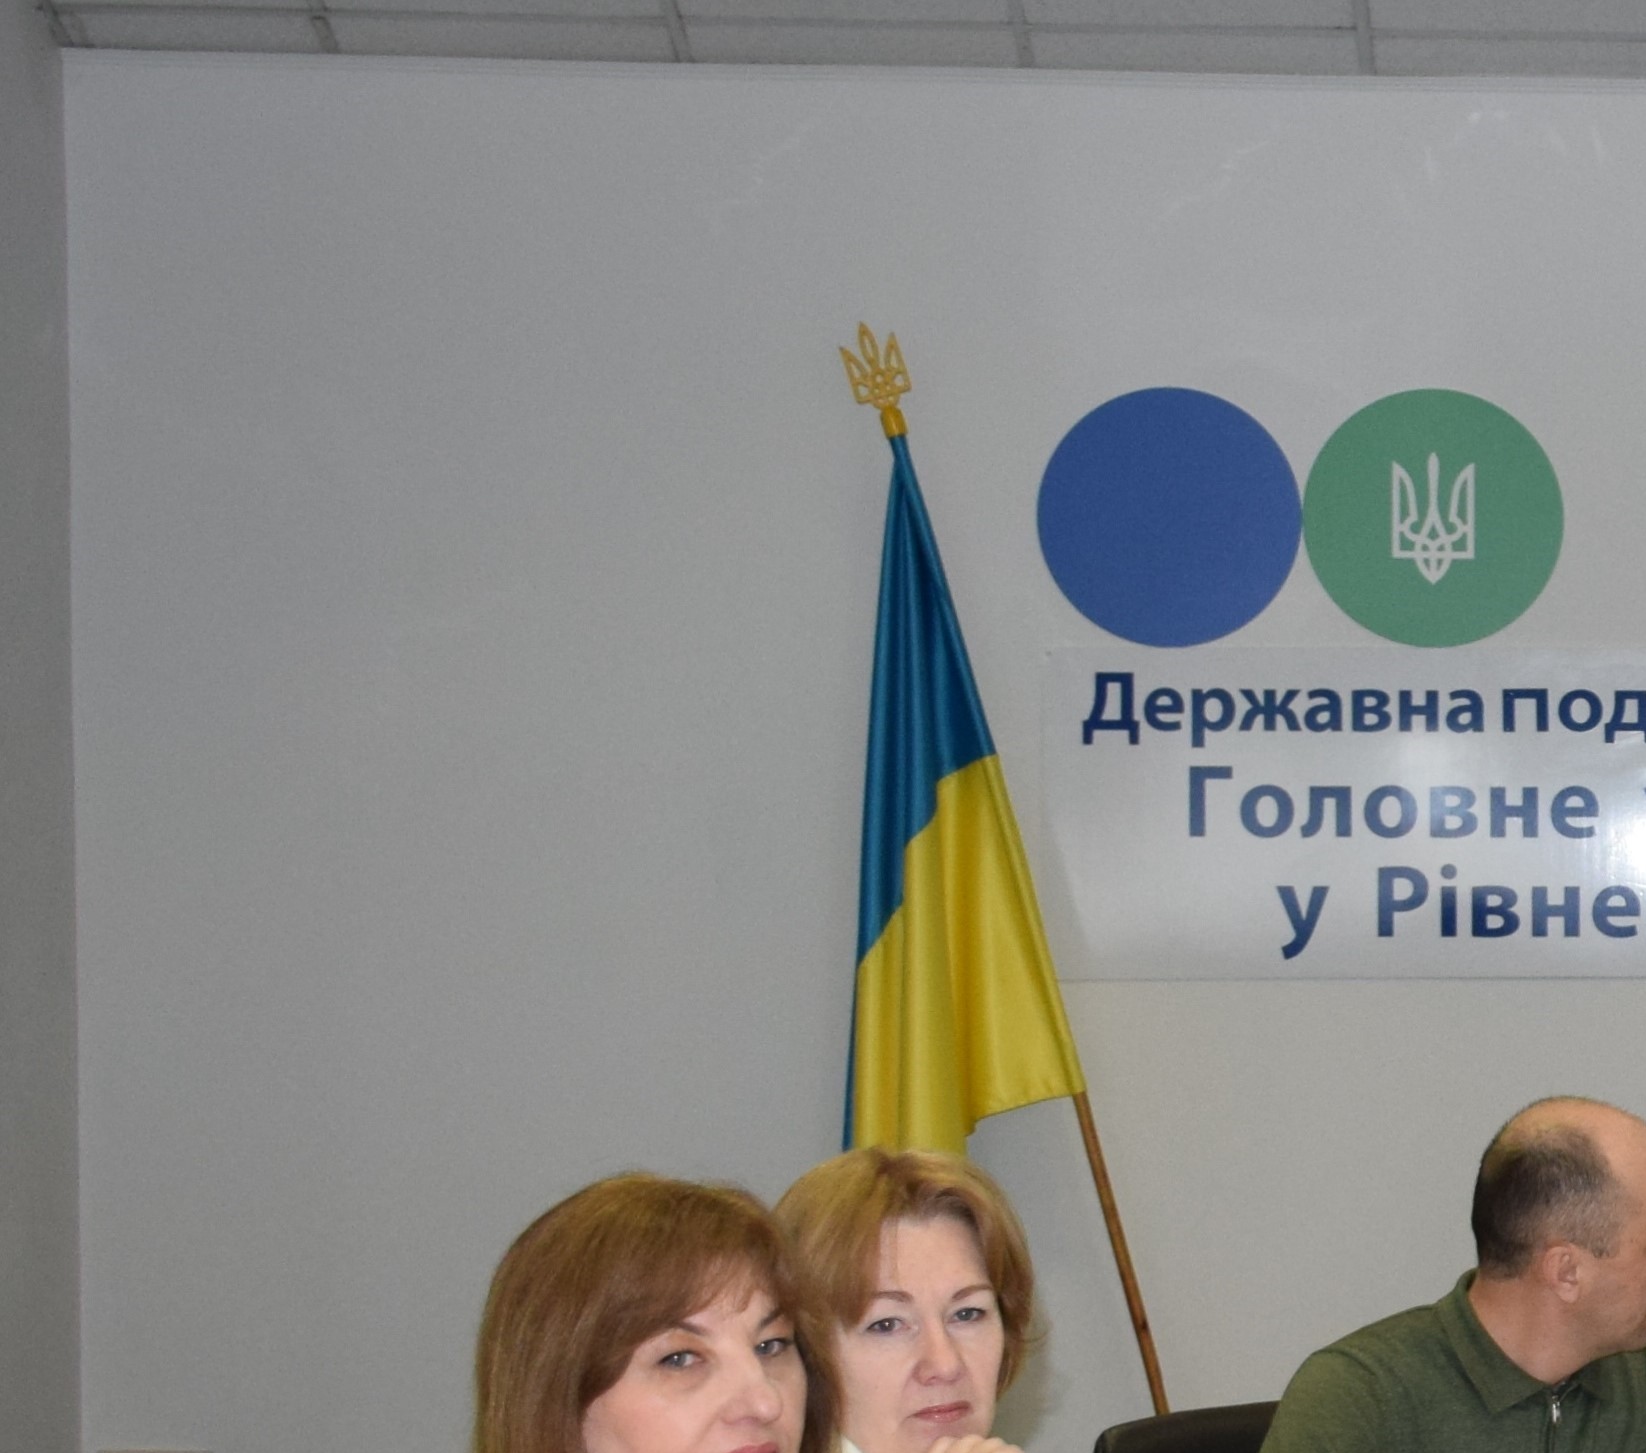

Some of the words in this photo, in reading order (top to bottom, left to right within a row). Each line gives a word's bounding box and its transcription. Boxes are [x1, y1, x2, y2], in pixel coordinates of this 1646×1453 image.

[1082, 672, 1485, 747] Державна
[1188, 766, 1600, 839] Головне
[1277, 885, 1330, 960] у
